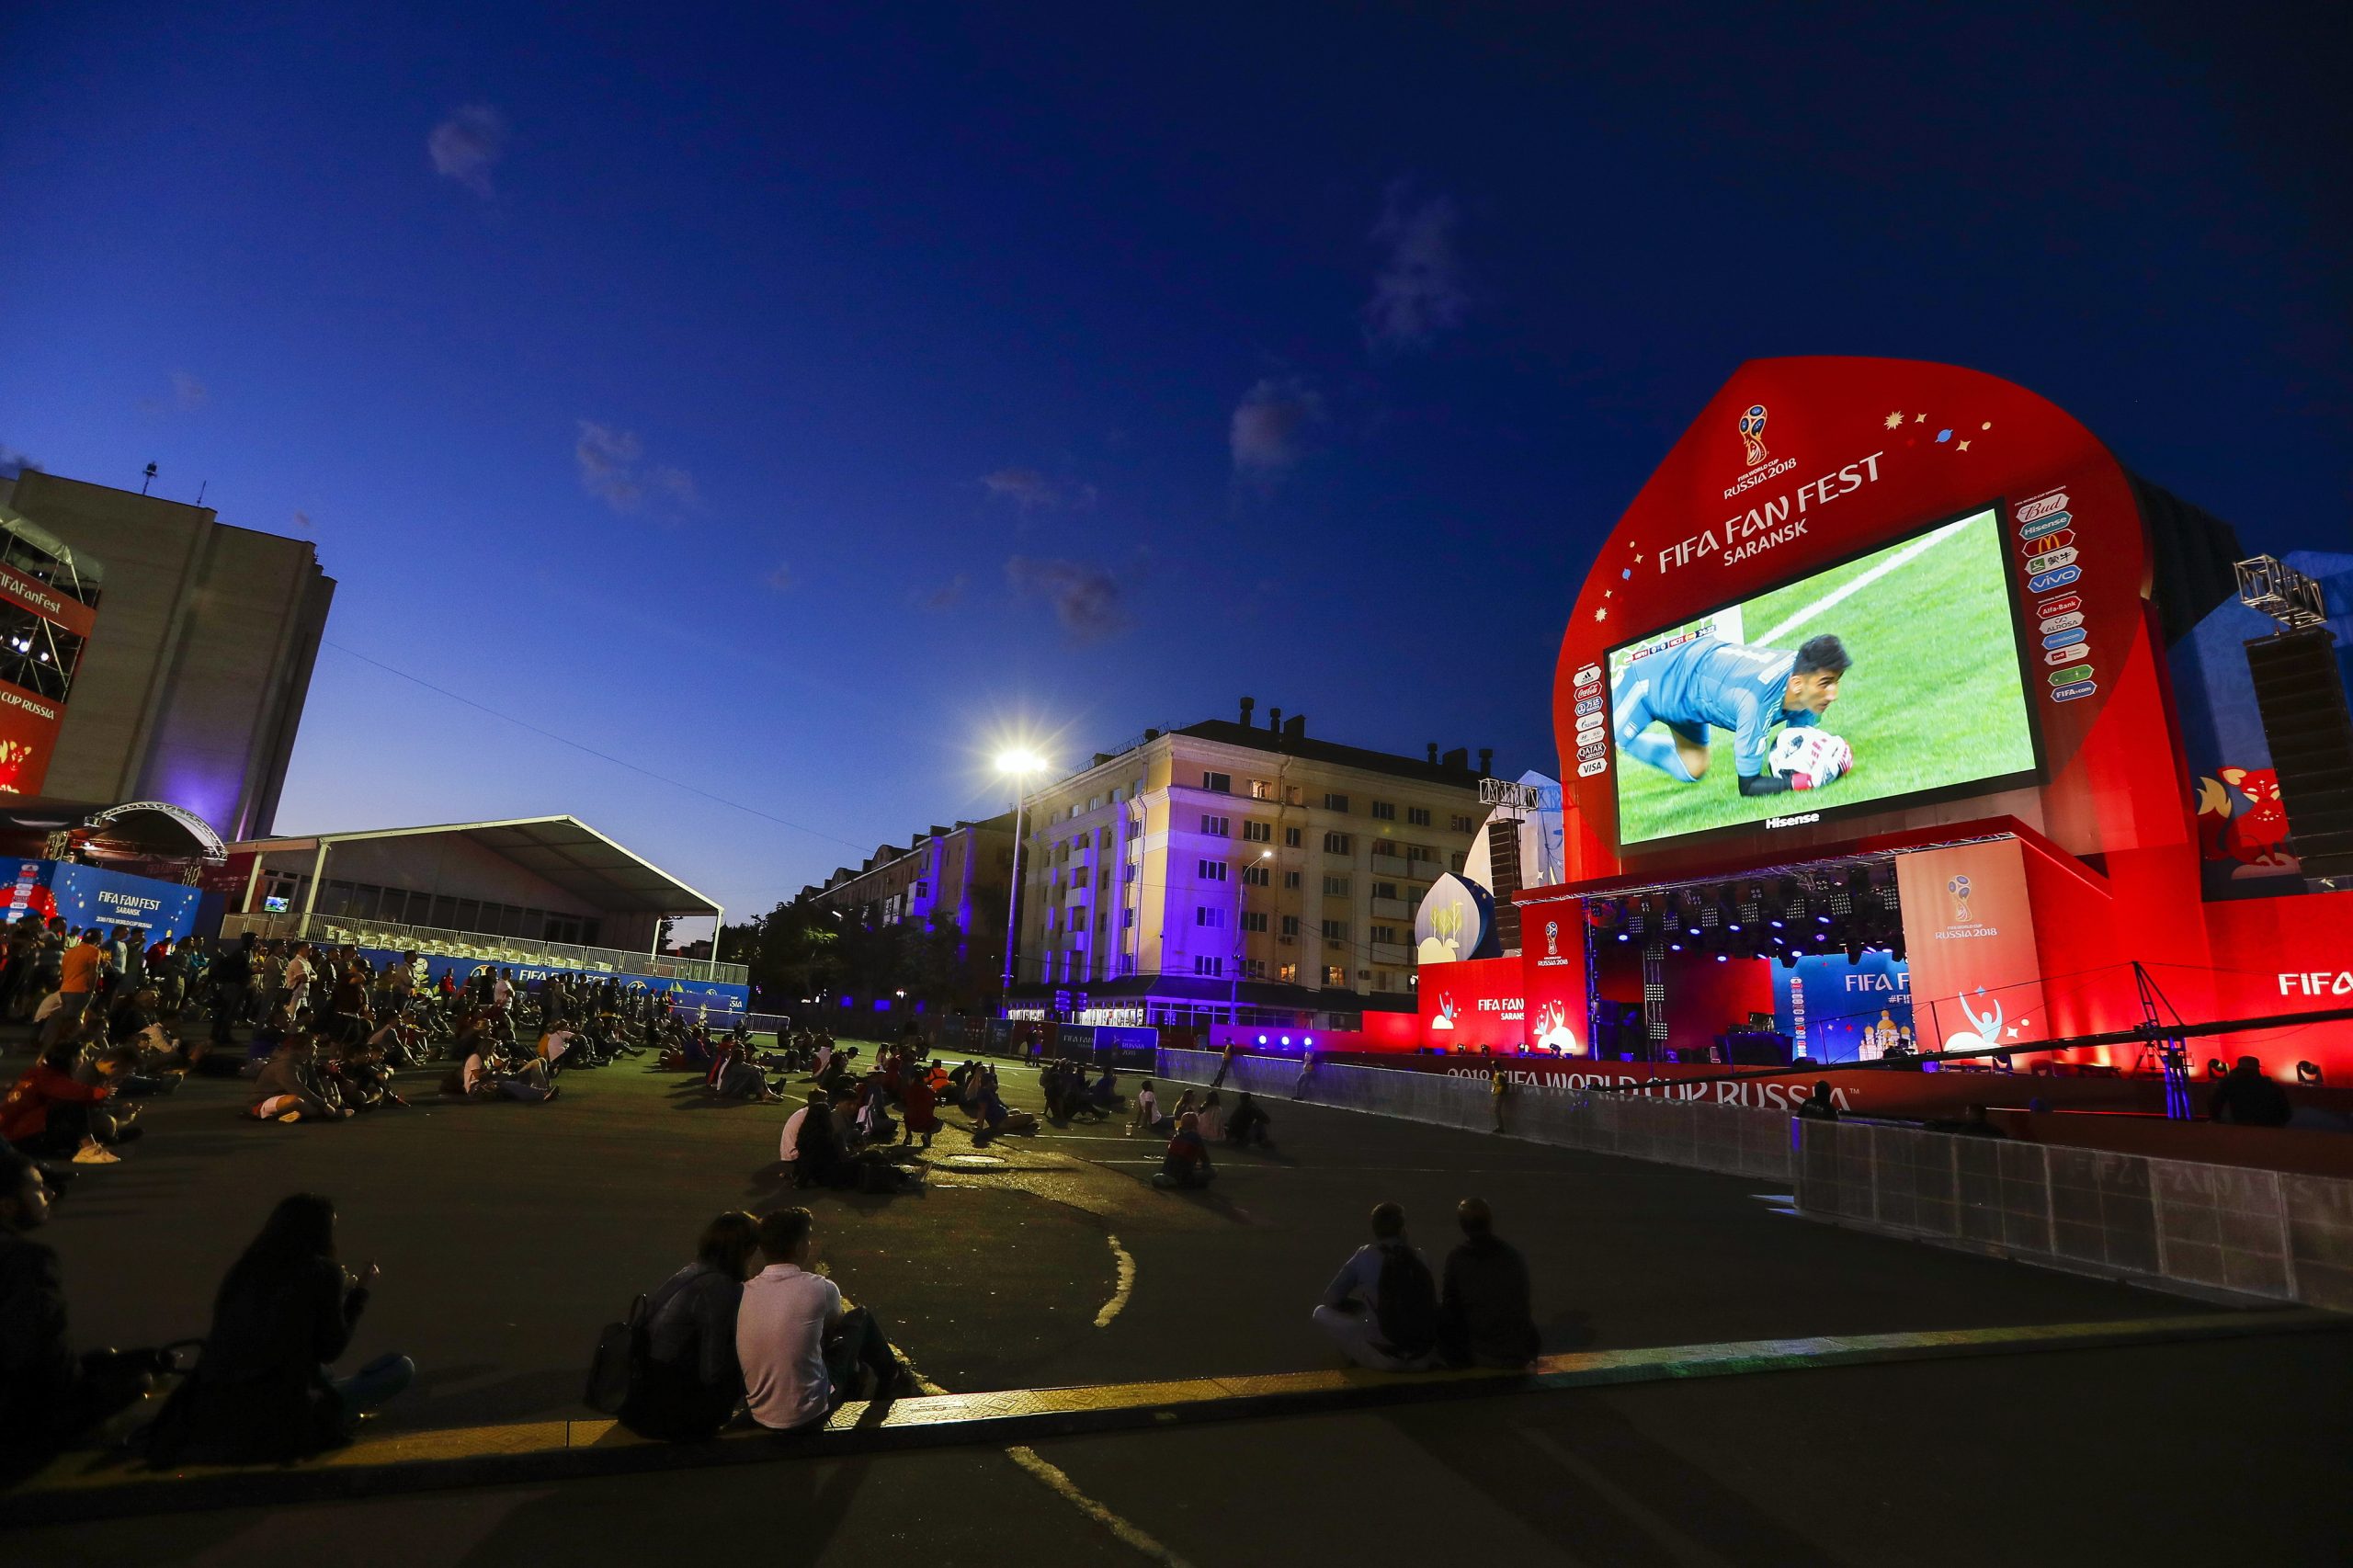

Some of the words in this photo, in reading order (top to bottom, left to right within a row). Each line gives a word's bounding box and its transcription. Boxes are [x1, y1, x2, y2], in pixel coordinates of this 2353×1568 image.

[1748, 463, 1768, 477] WORLD
[1768, 459, 1779, 468] CUP
[1723, 472, 1768, 499] RUSSIA
[1768, 458, 1797, 479] 2018
[1658, 529, 1720, 574] FIFA
[1725, 495, 1790, 545] FAN
[1797, 451, 1883, 513] FEST
[2020, 496, 2062, 520] Bud
[2025, 517, 2067, 536] Hisense
[1723, 518, 1808, 566] SARANSK
[2042, 600, 2076, 615] Alfa-Bank
[2046, 619, 2078, 632] ALROSA
[1, 691, 22, 705] CUP
[22, 698, 54, 720] RUSSIA
[1579, 744, 1603, 757] QATAR
[1583, 761, 1602, 773] VISA
[1766, 812, 1820, 829] Hisense
[98, 891, 119, 904] FIFA
[119, 894, 139, 907] FAN
[139, 898, 162, 911] FEST
[115, 906, 142, 916] SARANSK
[1935, 929, 1972, 939] RUSSIA
[1973, 927, 1997, 937] 2018
[518, 970, 547, 983] FIFA
[1845, 973, 1893, 992] FIFA
[2278, 971, 2353, 995] FIFA
[1478, 998, 1501, 1011] FIFA
[1502, 998, 1525, 1011] FAN
[1500, 1012, 1525, 1020] SARANS
[1121, 1041, 1145, 1051] RUSSIA
